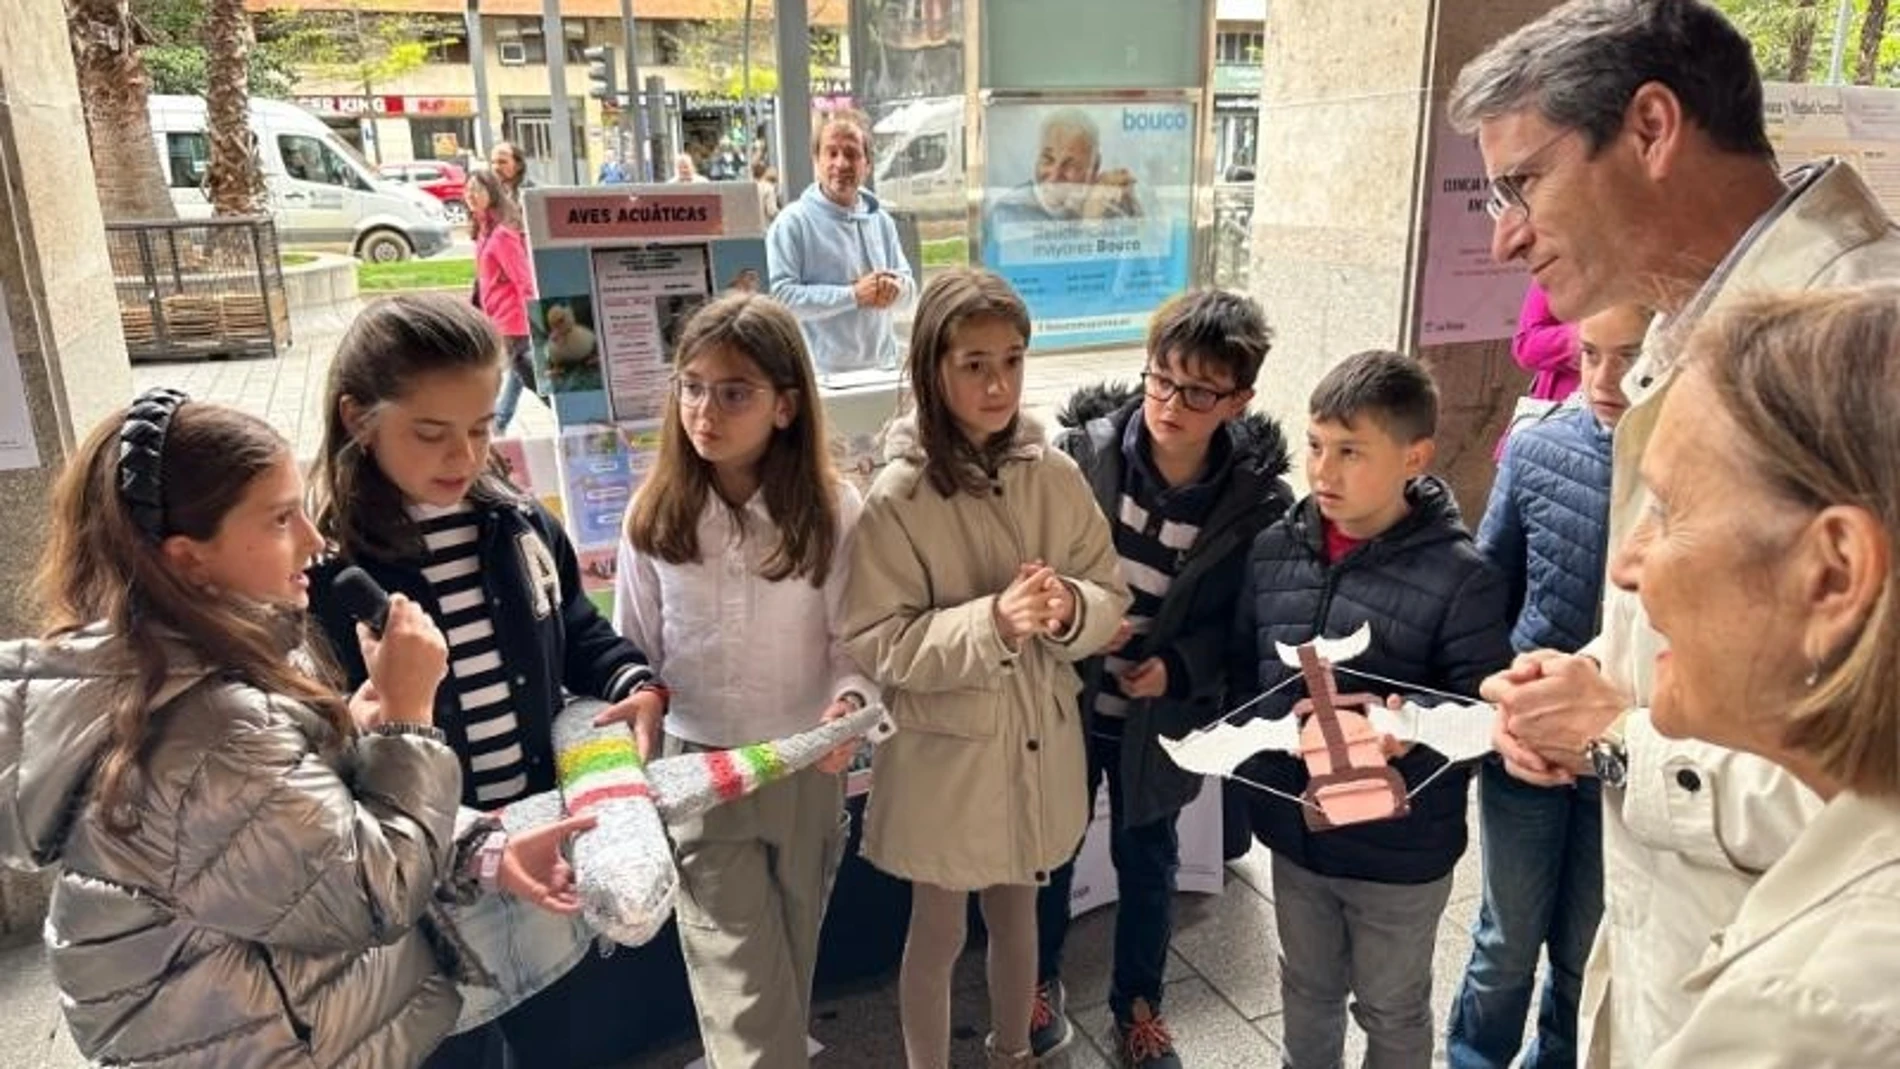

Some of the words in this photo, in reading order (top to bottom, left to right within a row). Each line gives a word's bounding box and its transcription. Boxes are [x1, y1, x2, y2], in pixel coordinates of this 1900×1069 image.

[1123, 107, 1187, 131] bouco
[568, 208, 610, 224] AVES
[1097, 239, 1141, 253] Bouco
[516, 532, 562, 618] A
